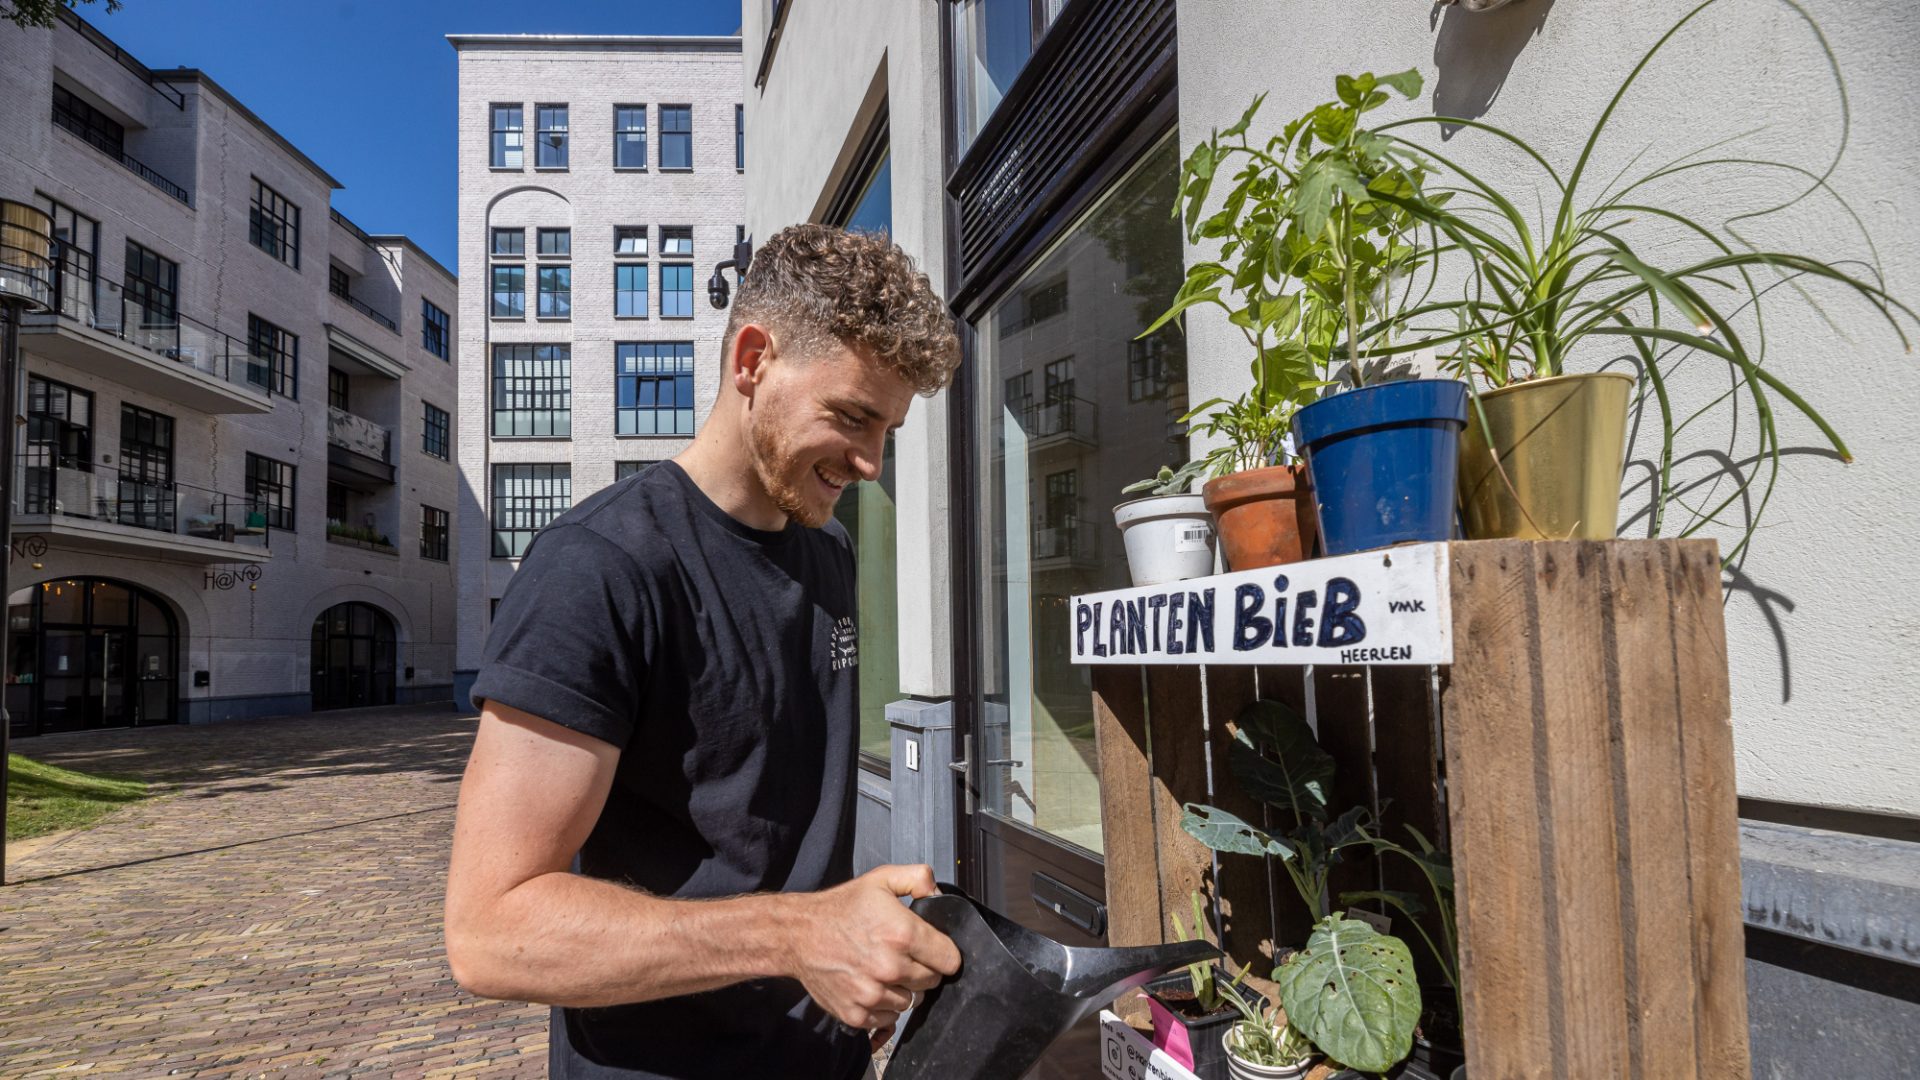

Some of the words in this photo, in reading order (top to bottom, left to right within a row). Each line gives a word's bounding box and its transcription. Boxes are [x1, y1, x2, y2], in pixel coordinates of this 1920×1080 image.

[1388, 599, 1426, 614] VMK
[1076, 587, 1216, 658] PLANTEN
[1340, 645, 1412, 664] HEERLEN
